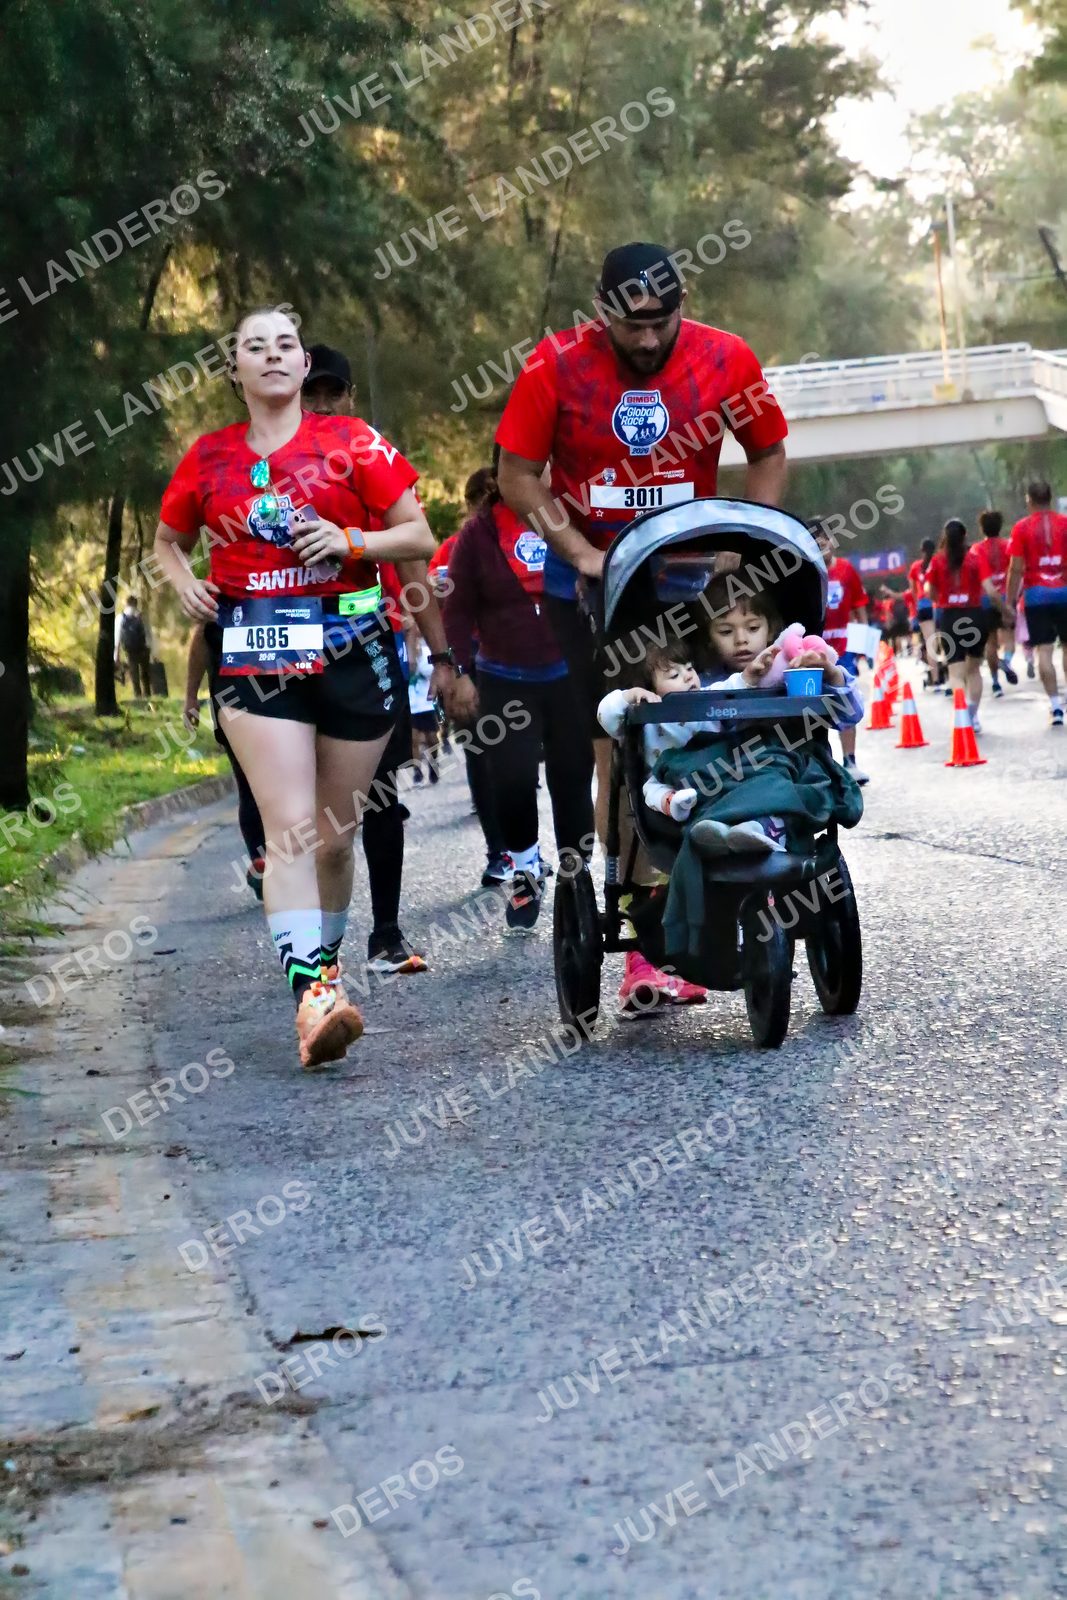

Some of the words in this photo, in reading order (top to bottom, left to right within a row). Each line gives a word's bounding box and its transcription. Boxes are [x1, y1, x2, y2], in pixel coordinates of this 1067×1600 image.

[626, 396, 656, 404] BIMBO
[627, 407, 656, 417] Global
[621, 416, 645, 426] Race
[624, 487, 663, 507] 3011
[246, 627, 289, 649] 4685
[295, 662, 313, 670] 10K
[706, 706, 738, 718] Jeep
